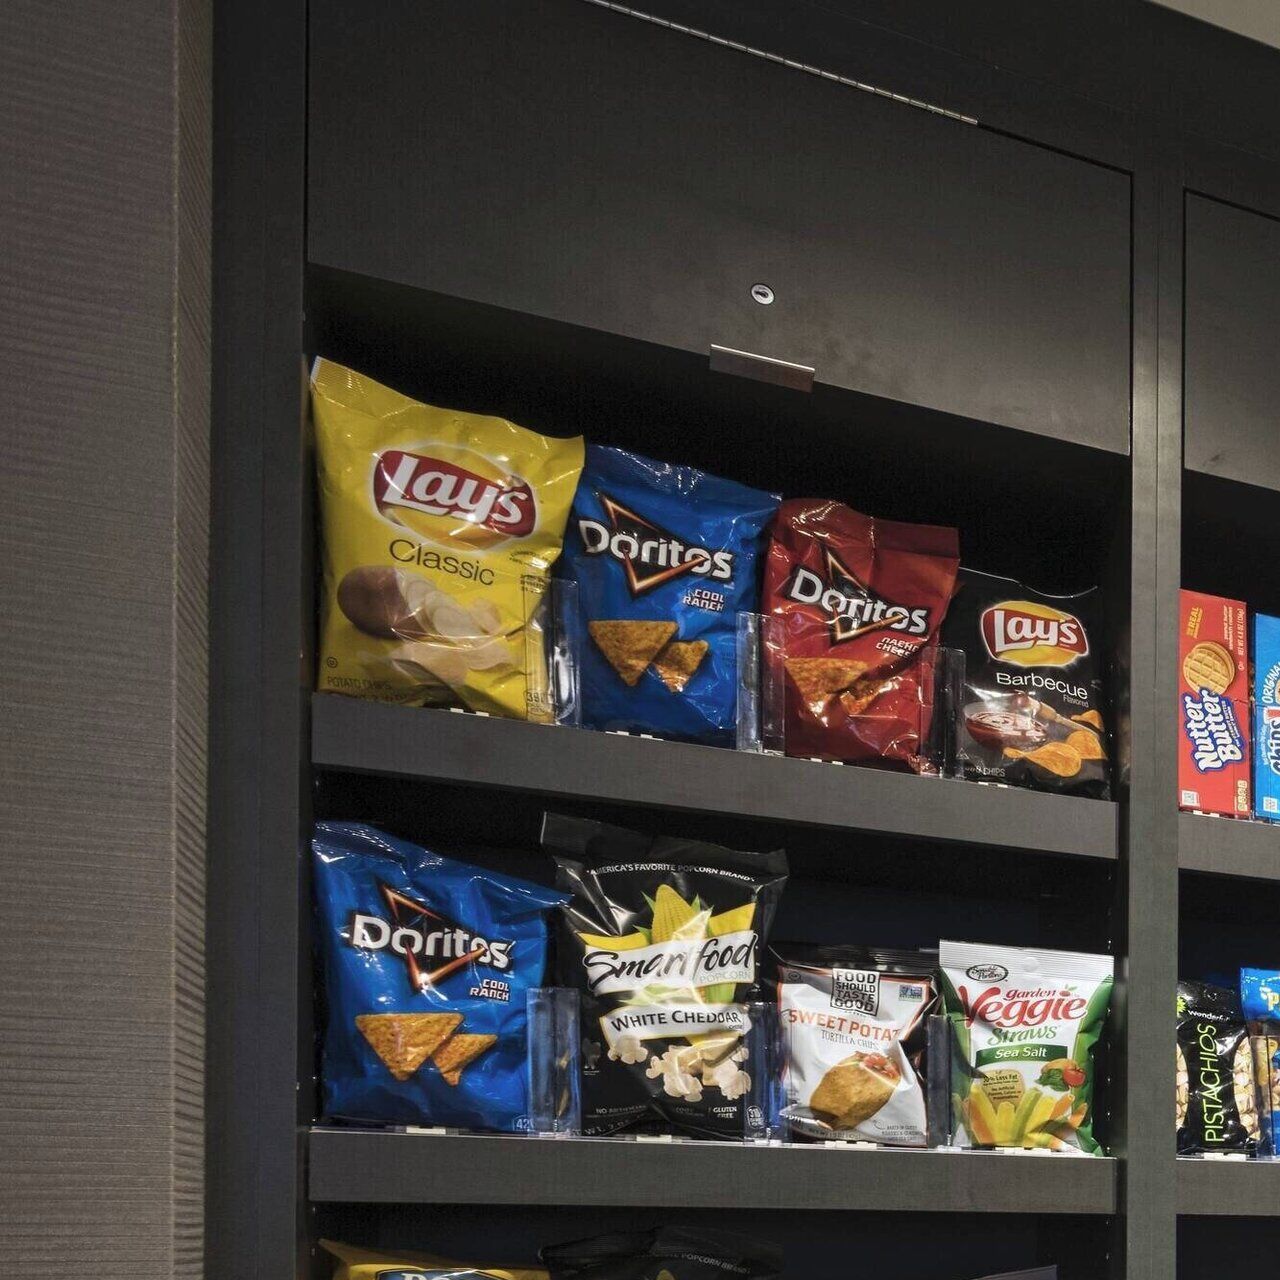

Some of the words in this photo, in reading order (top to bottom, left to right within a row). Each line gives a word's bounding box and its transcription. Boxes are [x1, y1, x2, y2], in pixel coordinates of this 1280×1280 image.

[378, 455, 528, 527] Lay's
[579, 519, 734, 580] Doritos
[389, 539, 494, 587] Classic
[682, 596, 725, 613] RANCH
[694, 588, 725, 605] COOL
[790, 569, 928, 635] Doritos
[994, 610, 1079, 652] Lay's
[996, 672, 1088, 700] Barbecue
[1184, 696, 1223, 771] Nutter
[1202, 689, 1243, 761] Butter
[352, 914, 516, 970] Doritos
[482, 979, 509, 991] COOL
[835, 982, 876, 993] SHOULD
[836, 970, 876, 984] FOOD
[470, 986, 510, 1001] RANCH
[835, 990, 875, 1001] TASTE
[1003, 988, 1056, 1000] garden
[959, 985, 1087, 1028] Veggie
[611, 1013, 667, 1033] WHITE
[671, 1010, 743, 1025] CHEDDAR
[987, 1026, 1057, 1045] Straws
[994, 1049, 1020, 1059] Sea
[1022, 1047, 1047, 1058] Salt
[1197, 1023, 1225, 1142] PISTACHIOS
